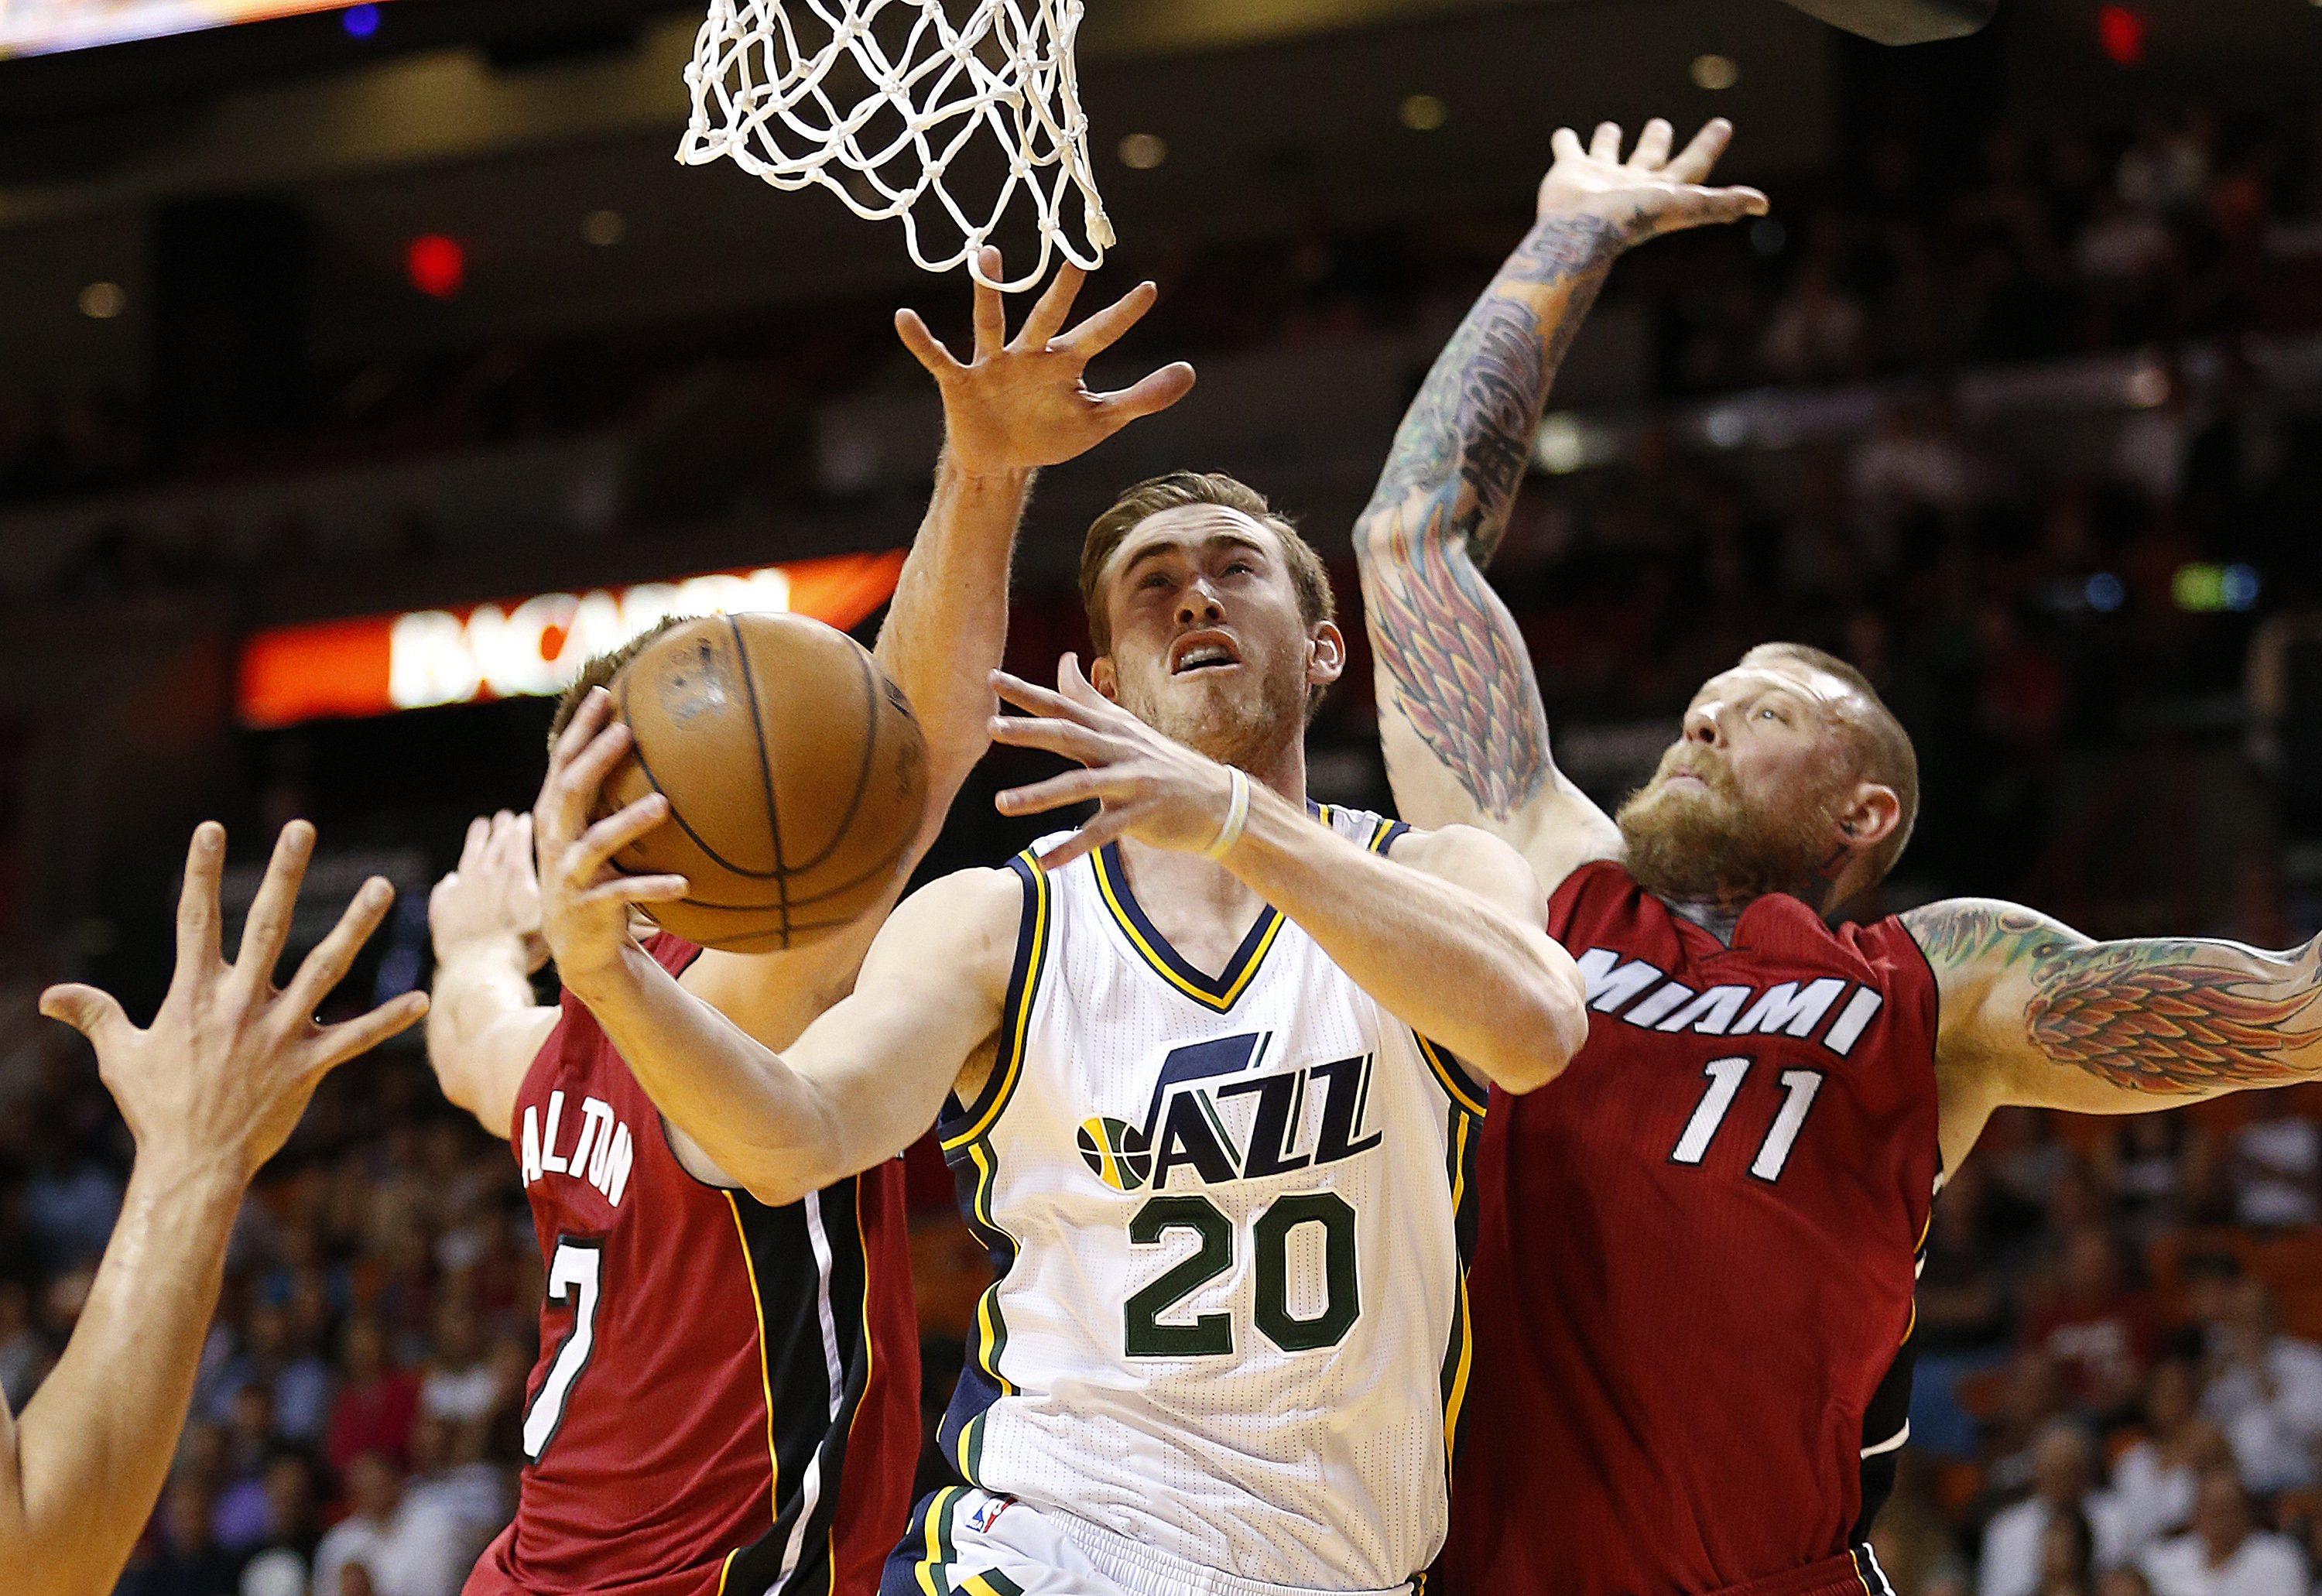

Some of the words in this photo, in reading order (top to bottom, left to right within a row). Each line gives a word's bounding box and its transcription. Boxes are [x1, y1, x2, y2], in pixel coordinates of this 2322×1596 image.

[1577, 947, 1883, 1056] MIAMI
[1142, 1030, 1382, 1190] JAZZ
[1670, 1056, 1824, 1183] 11
[523, 1240, 602, 1461] 7
[1124, 1190, 1361, 1358] 20
